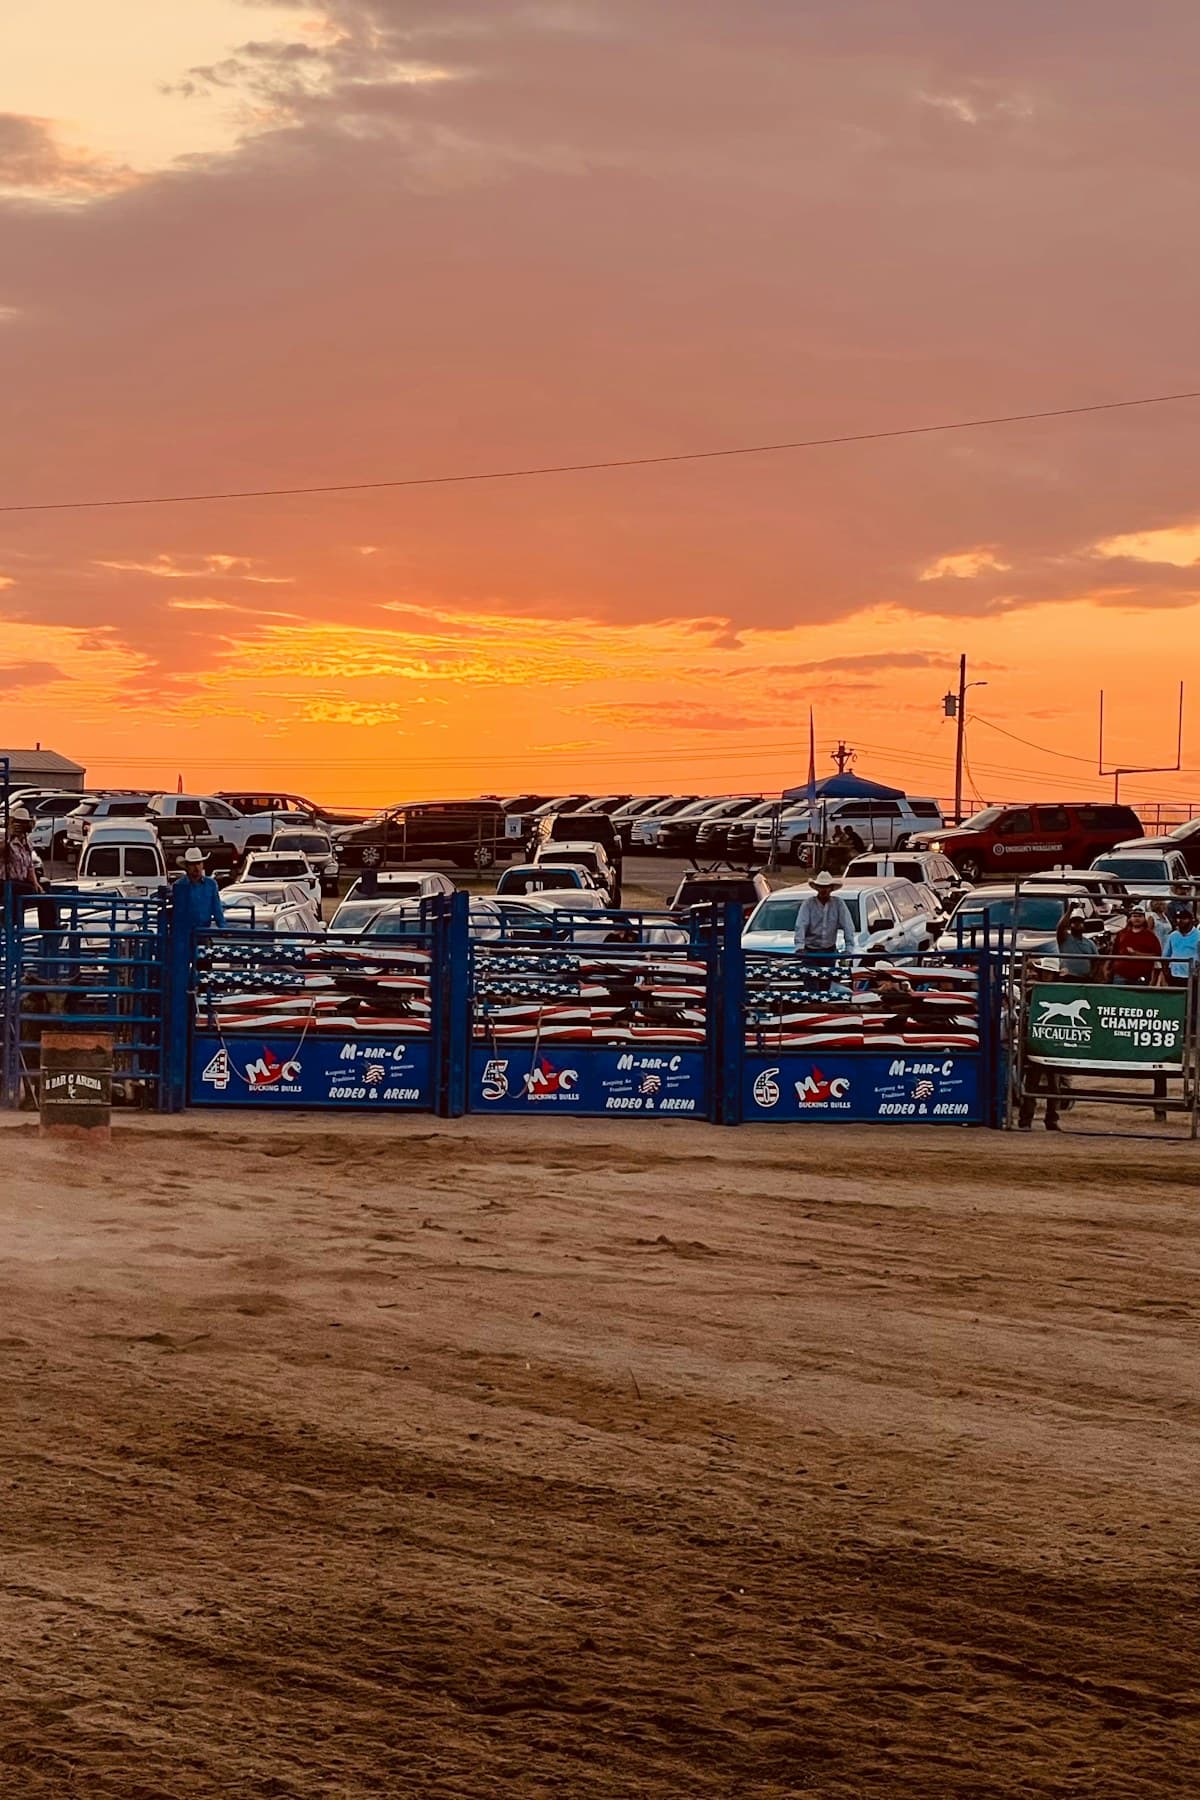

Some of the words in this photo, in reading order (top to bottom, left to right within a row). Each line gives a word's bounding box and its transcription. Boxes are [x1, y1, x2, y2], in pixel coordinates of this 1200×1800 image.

[1097, 1006, 1117, 1016] THE
[1118, 1007, 1143, 1018] FEED
[1145, 1009, 1159, 1018] OF
[1100, 1016, 1180, 1032] CHAMPIONS
[1133, 1031, 1175, 1047] 1938
[340, 1043, 406, 1061] M-BAR-C
[202, 1048, 231, 1090] 4
[616, 1054, 682, 1072] M-BAR-C
[888, 1060, 954, 1077] M-BAR-C
[68, 1074, 75, 1085] C
[75, 1074, 102, 1090] ARENA
[481, 1060, 509, 1100] 5
[753, 1067, 780, 1108] 6
[328, 1086, 366, 1100] RODEO
[369, 1087, 378, 1099] &
[383, 1087, 420, 1100] ARENA
[606, 1097, 642, 1110] RODEO
[645, 1098, 655, 1109] &
[659, 1098, 696, 1111] ARENA
[878, 1103, 916, 1115] RODEO
[918, 1103, 928, 1114] &
[932, 1103, 969, 1115] ARENA
